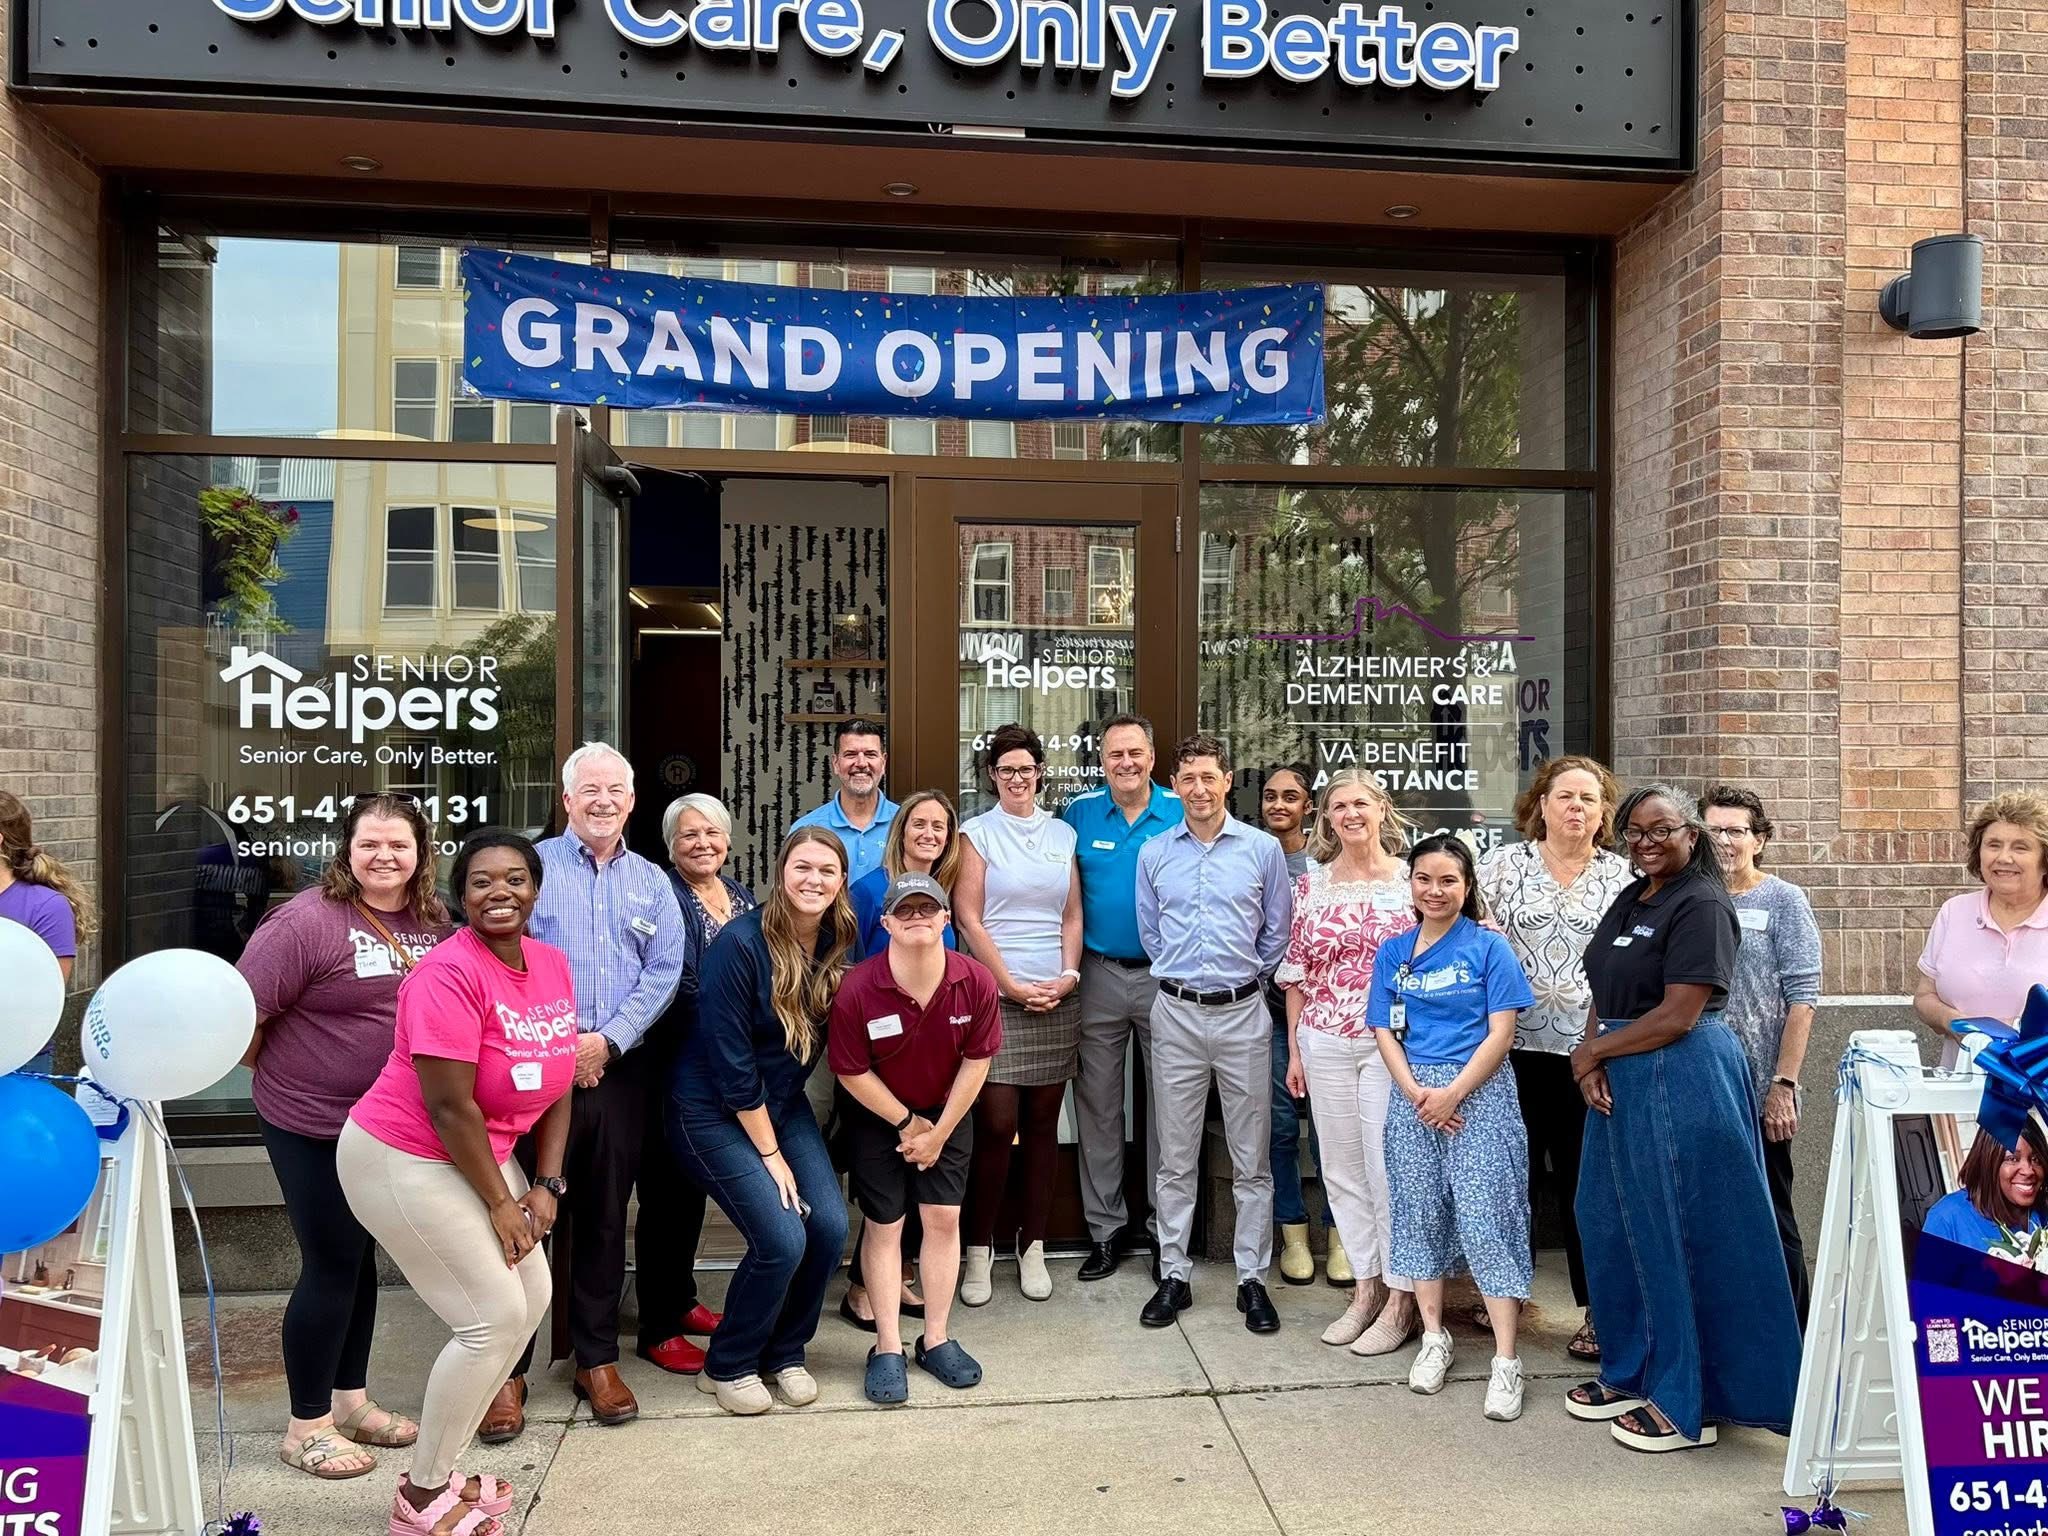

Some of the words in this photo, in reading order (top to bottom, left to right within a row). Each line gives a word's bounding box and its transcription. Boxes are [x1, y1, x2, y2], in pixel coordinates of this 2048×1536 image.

[928, 0, 1176, 98] Only
[1203, 0, 1518, 92] Better
[501, 297, 842, 392] GRAND
[874, 326, 1290, 400] OPENING
[1042, 649, 1116, 664] SENIOR
[1296, 656, 1467, 678] ALZHEIMER'S
[1474, 655, 1493, 679] &
[352, 654, 498, 683] SENIOR
[986, 658, 1117, 695] Helpers
[1286, 684, 1425, 705] DEMENTIA
[1432, 684, 1503, 705] CARE
[240, 672, 499, 743] Helpers
[240, 746, 306, 764] Senior
[313, 746, 368, 767] Care,
[375, 746, 424, 769] Only
[430, 746, 498, 765] Better.
[1320, 743, 1356, 763] VA
[1364, 742, 1472, 763] BENEFIT
[1059, 766, 1105, 777] HOURS
[1311, 770, 1479, 790] ASTANCE
[1058, 784, 1096, 792] FRIDAY
[228, 795, 488, 823] 651-41131
[392, 932, 438, 944] SENIOR
[527, 998, 573, 1021] SENIOR
[504, 1046, 532, 1058] Senior
[551, 1044, 570, 1056] Only
[1970, 1354, 1993, 1362] Senior
[1993, 1354, 2013, 1362] Care,
[2013, 1353, 2031, 1363] Only
[1972, 1378, 2044, 1416] WE
[1949, 1479, 2048, 1512] 651-4
